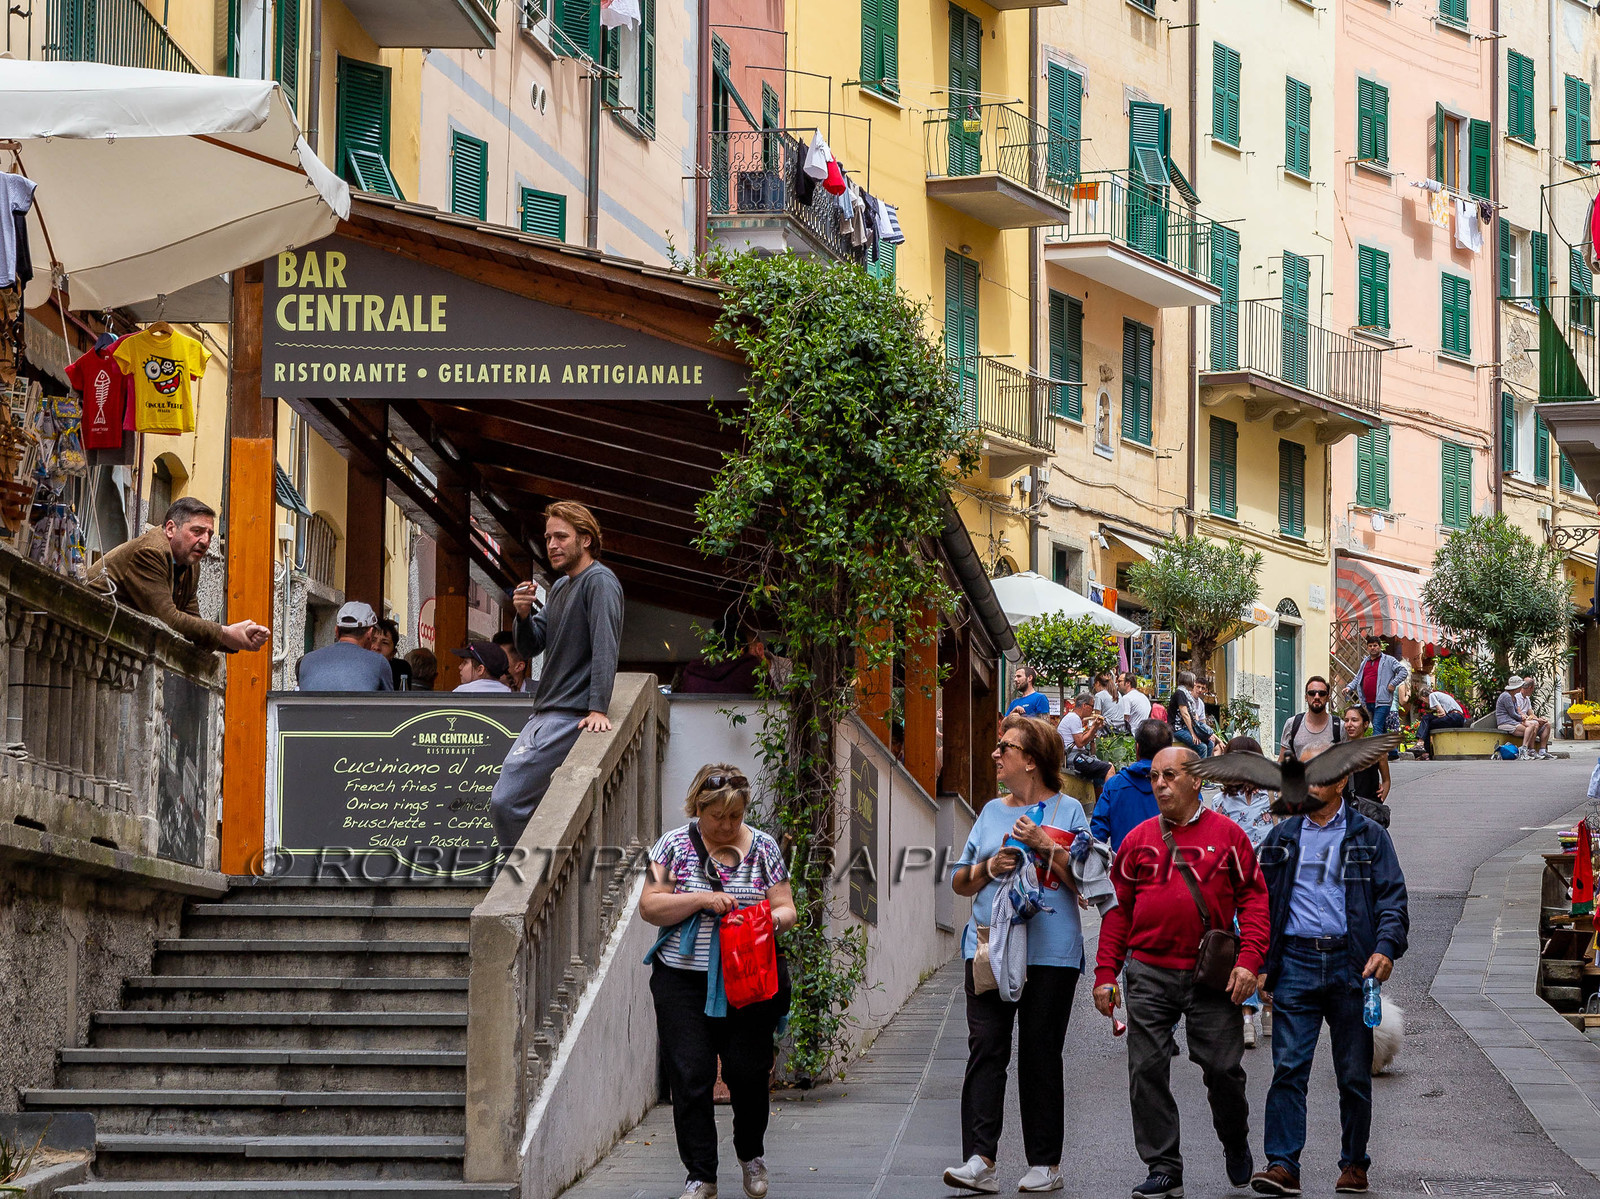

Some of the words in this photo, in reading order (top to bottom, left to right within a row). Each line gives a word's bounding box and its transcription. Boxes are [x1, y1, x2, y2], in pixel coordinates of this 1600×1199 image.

[277, 250, 347, 288] BAR
[275, 294, 447, 332] CENTRALE
[274, 362, 407, 382] RISTORANTE
[438, 363, 551, 383] GELATERIA
[561, 364, 703, 384] ARTIGIANALE
[418, 732, 437, 744] BAR
[440, 732, 484, 745] CENTRALE
[333, 757, 440, 775] Cuciniamo
[448, 757, 468, 775] al
[344, 778, 396, 793] French
[400, 780, 438, 793] fries
[346, 796, 388, 810] Onion
[393, 798, 429, 816] rings
[342, 816, 427, 829] Bruschette
[368, 834, 409, 847] Salad
[428, 835, 470, 848] Pasta
